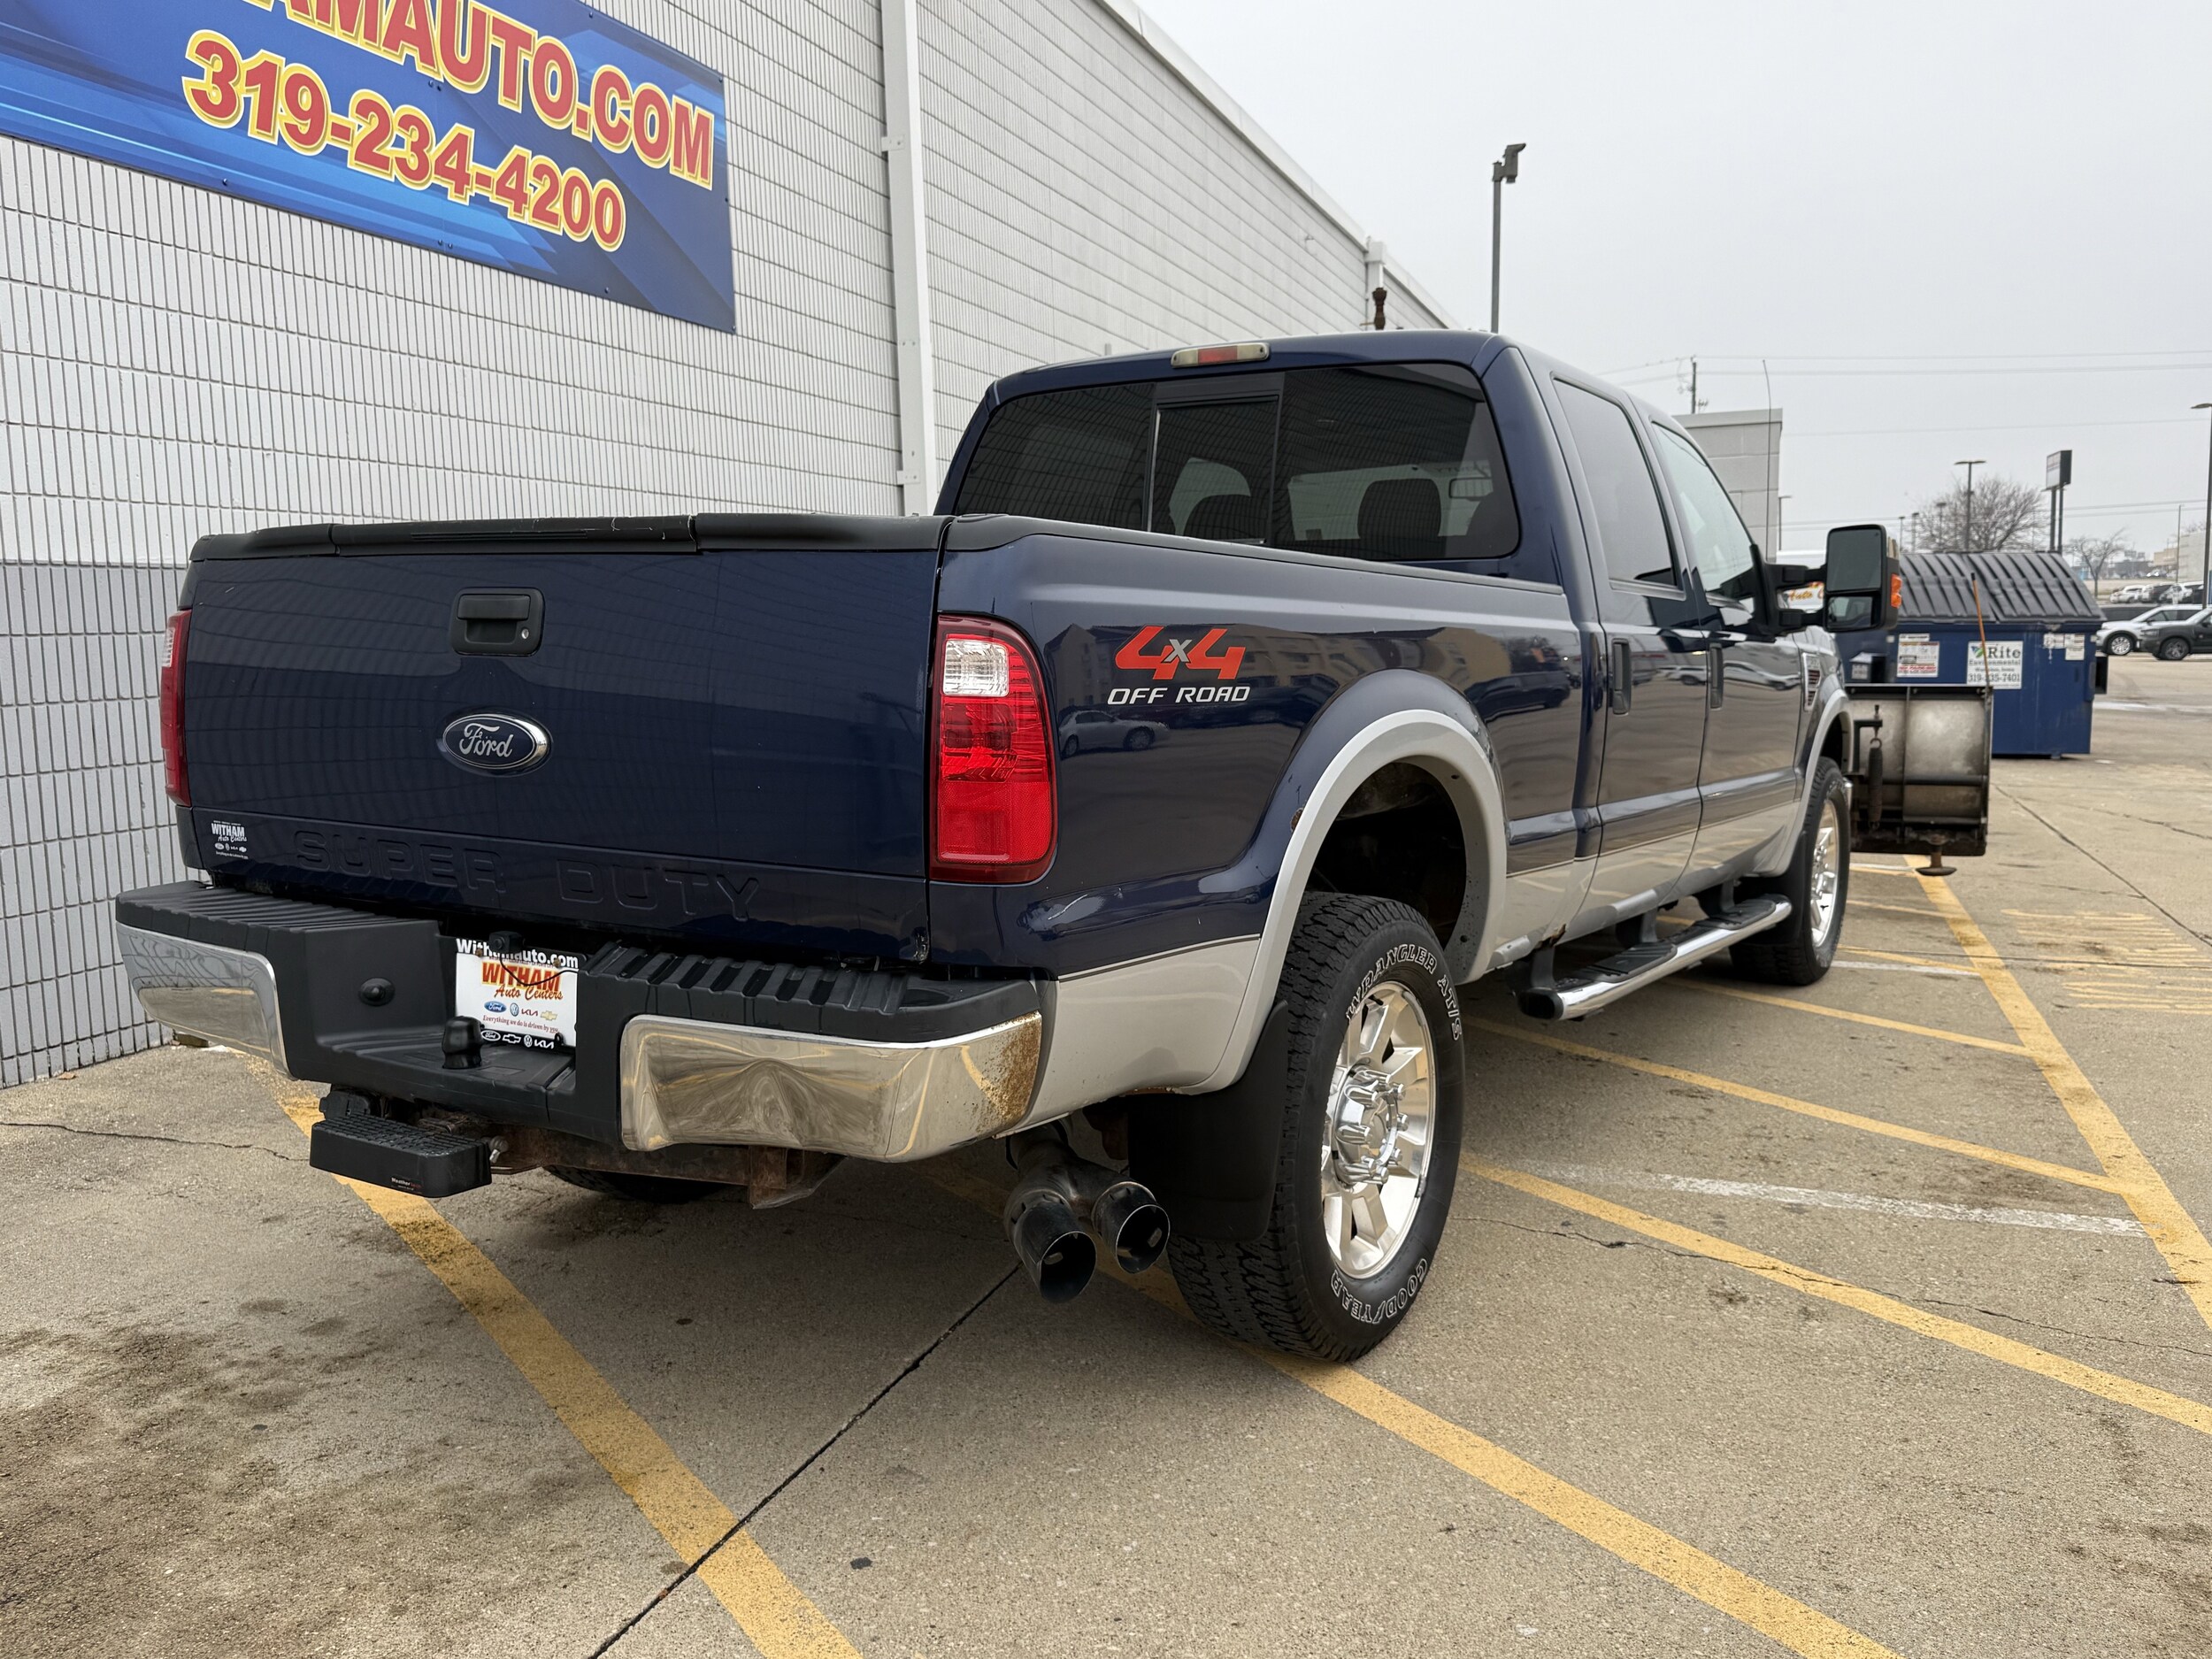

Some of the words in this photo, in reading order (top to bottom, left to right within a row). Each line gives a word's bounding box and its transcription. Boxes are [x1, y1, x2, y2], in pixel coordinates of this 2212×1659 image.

[285, 0, 715, 189] AUTO.COM
[181, 29, 626, 252] 319-234-4200
[1987, 646, 2021, 659] Rite
[1968, 673, 2020, 682] 319-35-7401
[1107, 687, 1168, 705] OFF
[1175, 686, 1251, 703] ROAD
[459, 722, 514, 757] Ford
[211, 823, 245, 837] WITHAM
[294, 830, 507, 894] SUPER
[556, 858, 760, 923] DUTY
[482, 961, 562, 992] WITHAM
[1346, 943, 1438, 1021] WRANGLER
[494, 984, 520, 998] Auto
[525, 986, 563, 1001] Centers
[482, 1014, 510, 1025] Everything
